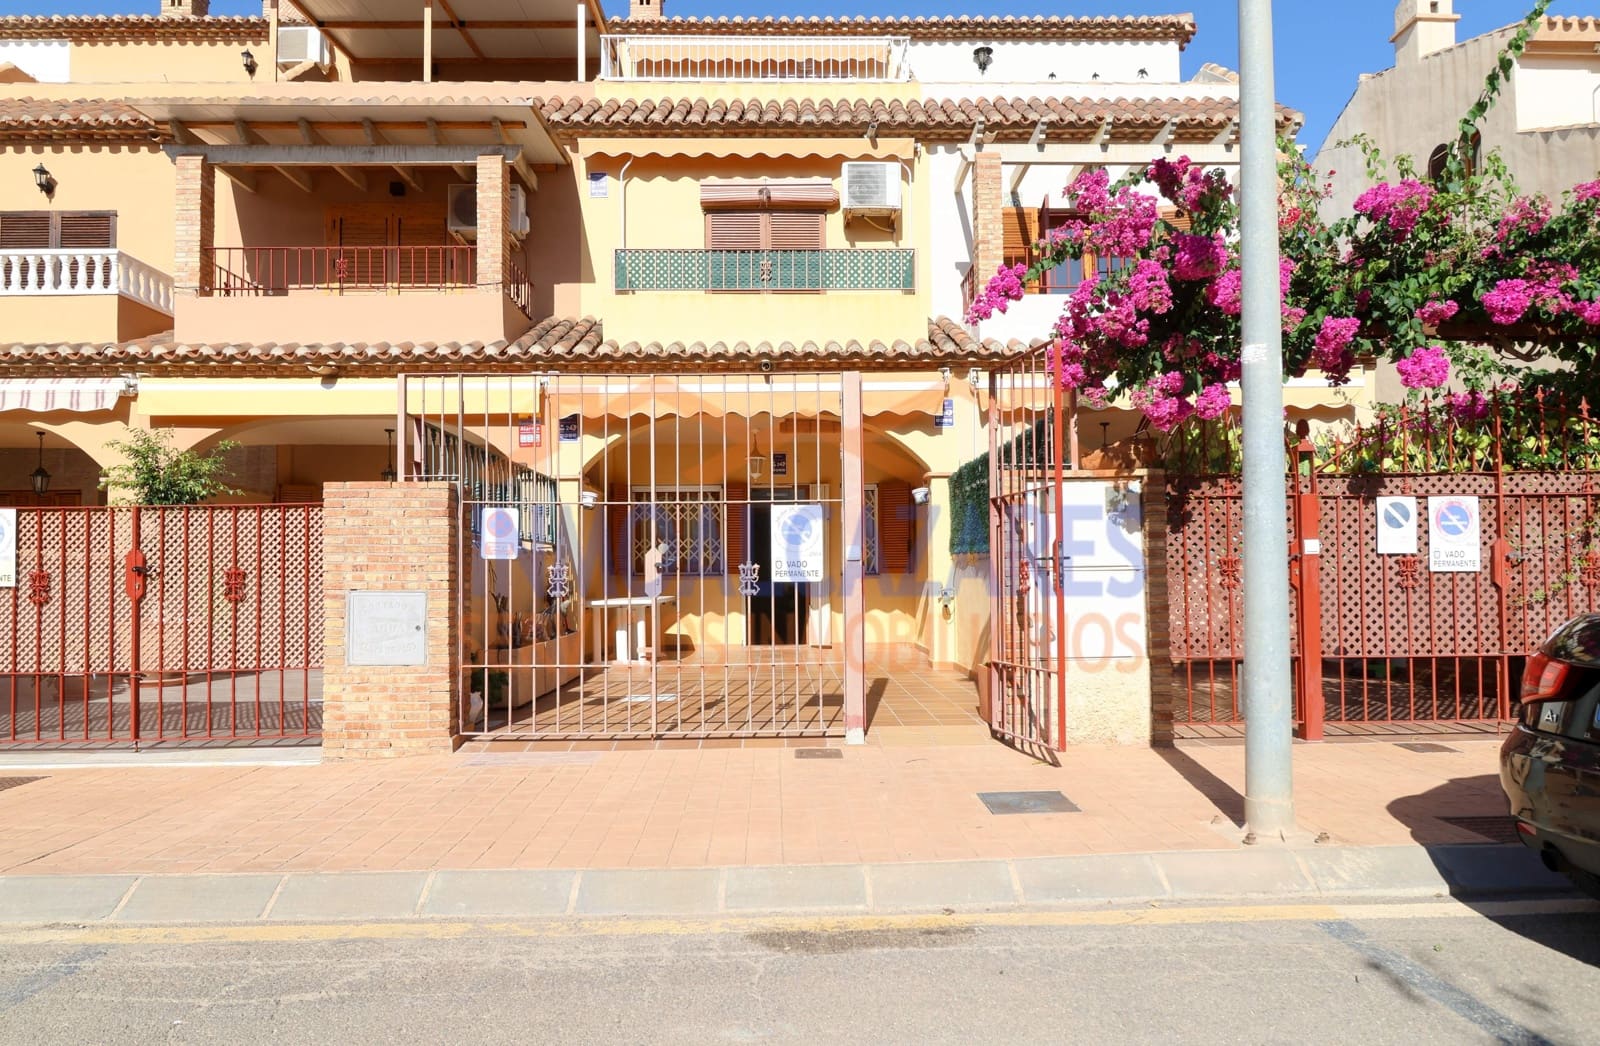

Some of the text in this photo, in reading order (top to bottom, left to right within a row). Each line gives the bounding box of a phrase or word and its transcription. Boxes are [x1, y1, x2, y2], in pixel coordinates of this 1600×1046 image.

[1445, 550, 1465, 558] VADO
[786, 560, 808, 568] VADO
[1433, 559, 1477, 567] PERMANENTE
[1544, 709, 1558, 722] A1
